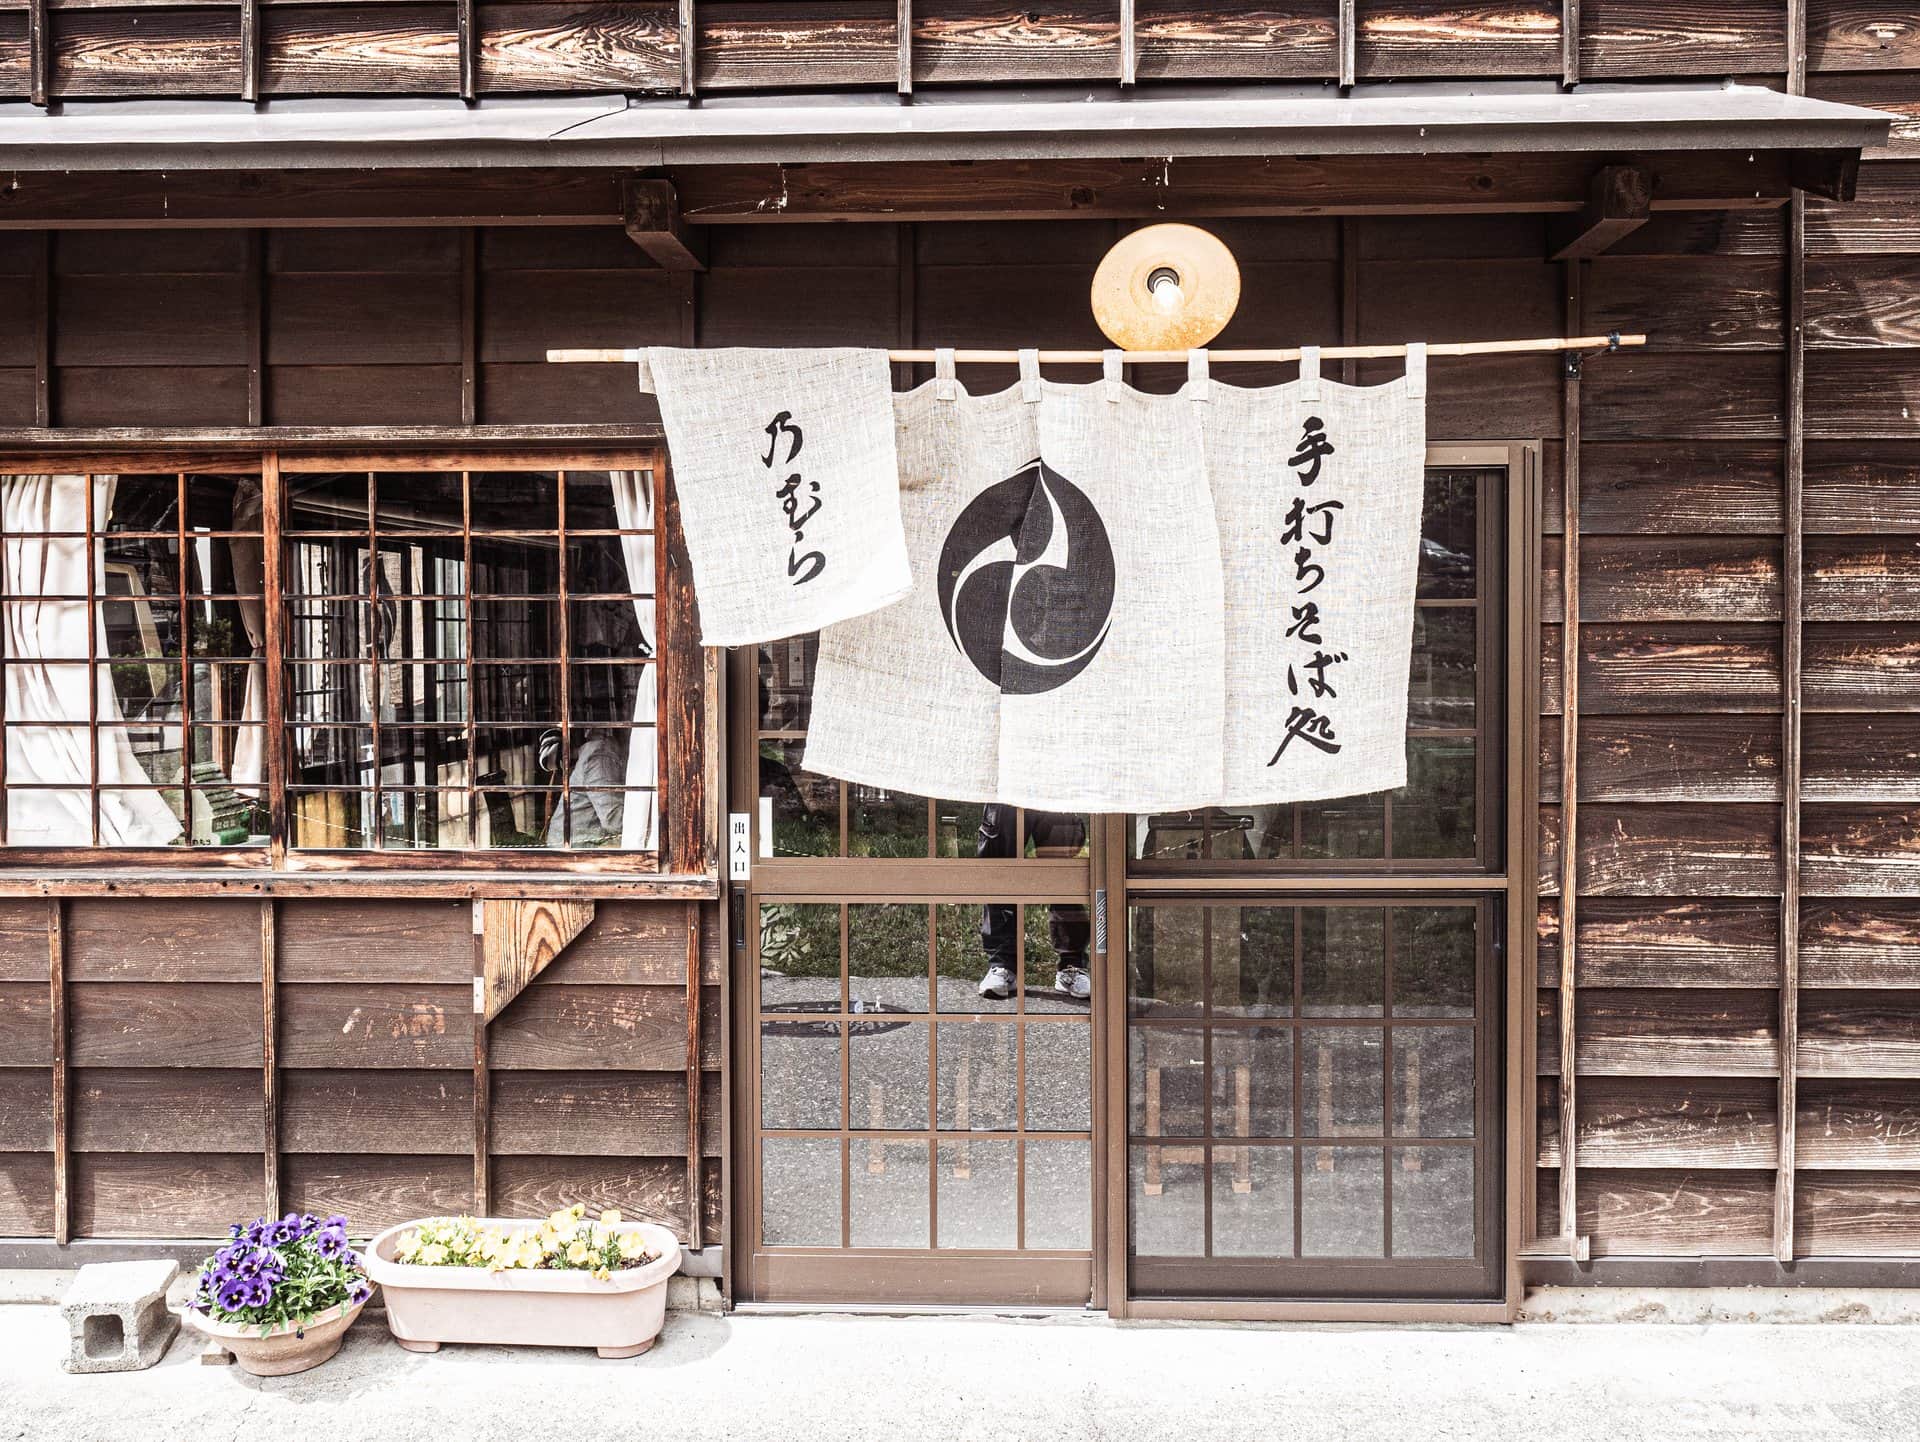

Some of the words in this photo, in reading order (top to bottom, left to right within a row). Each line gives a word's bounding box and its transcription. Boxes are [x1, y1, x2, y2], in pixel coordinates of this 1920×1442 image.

[761, 410, 826, 586] 乃むら
[1266, 415, 1349, 767] 手打ちそば処
[733, 821, 746, 873] 出入口
